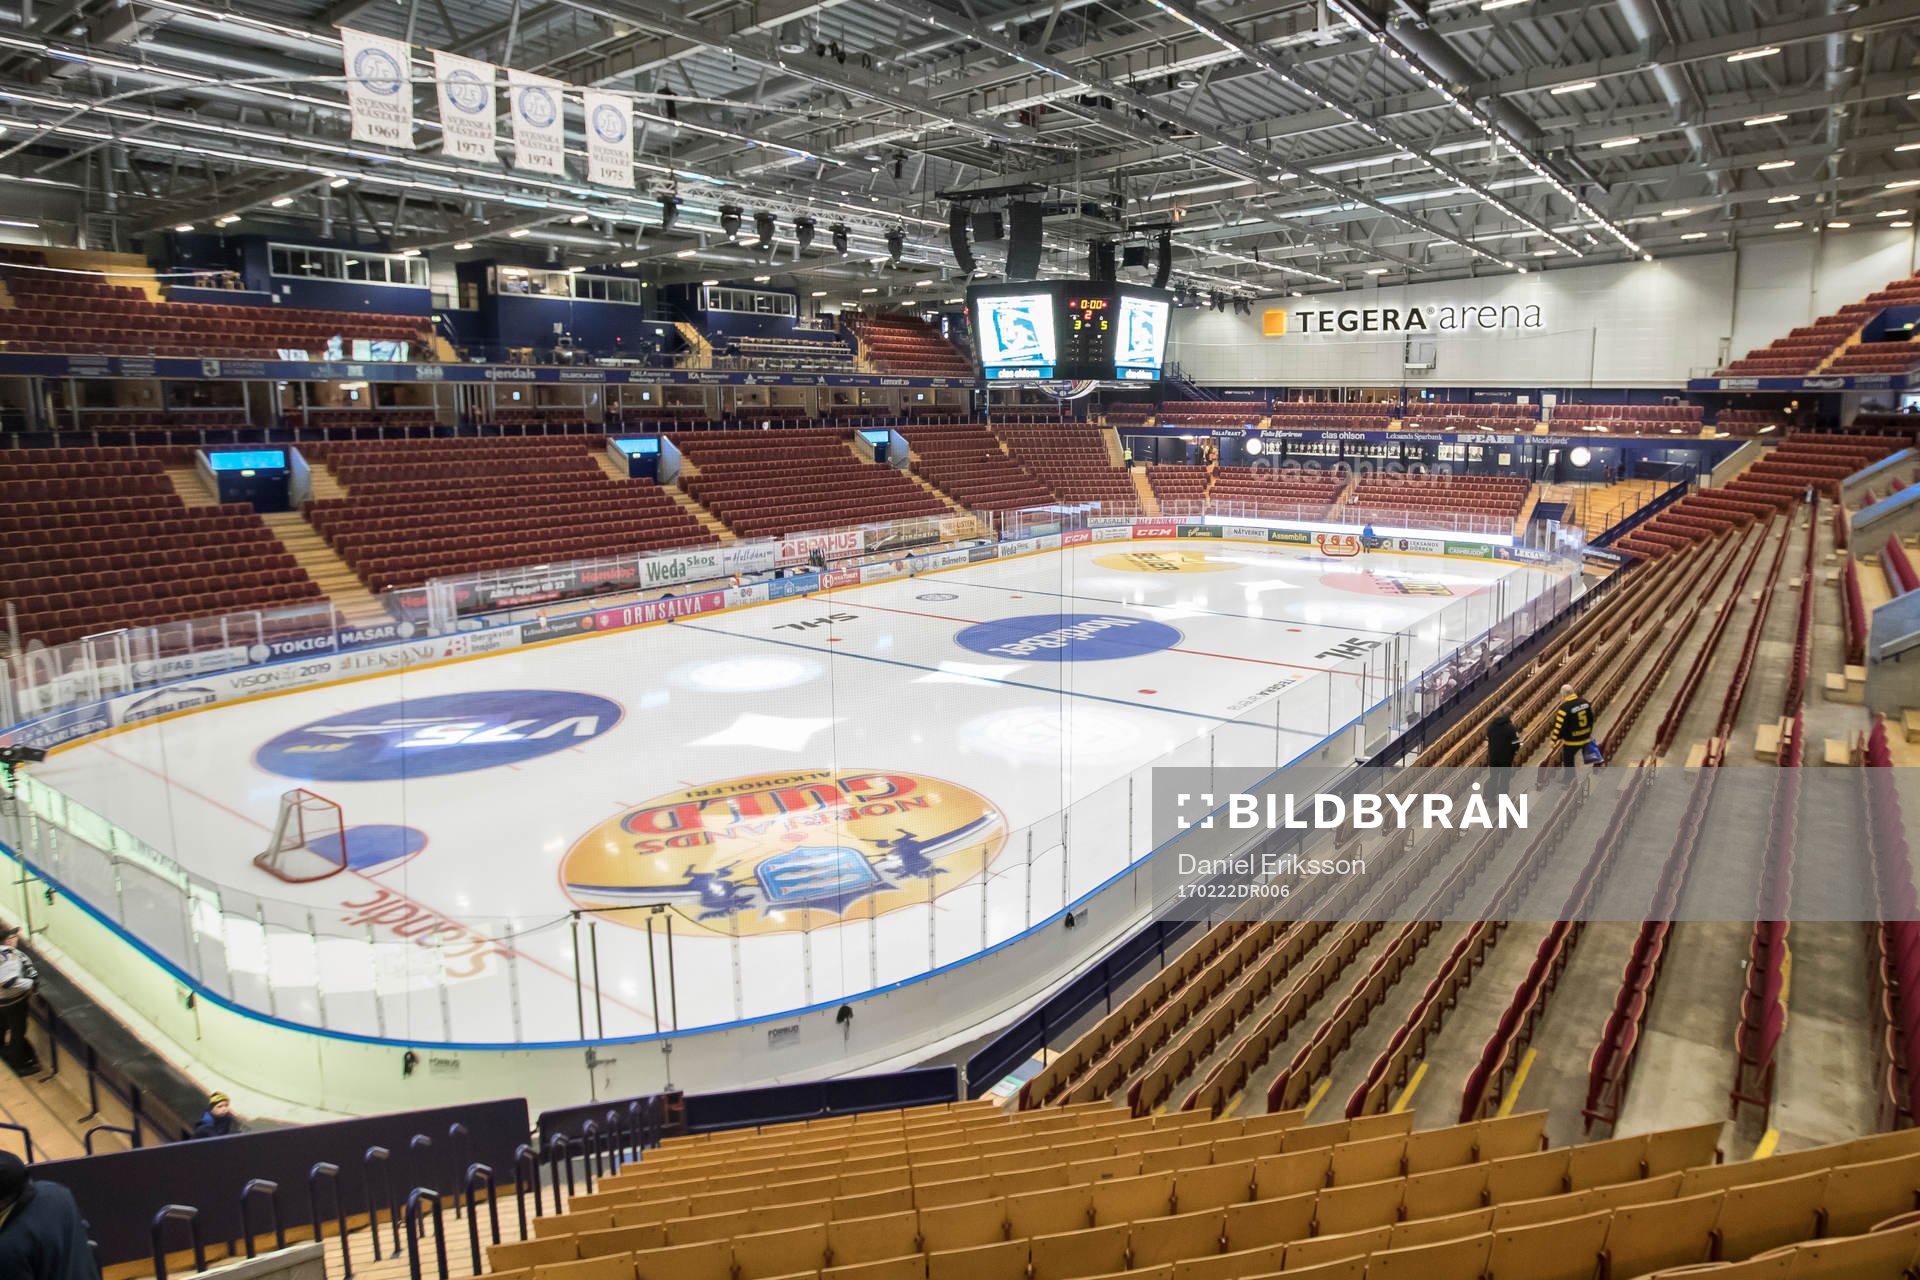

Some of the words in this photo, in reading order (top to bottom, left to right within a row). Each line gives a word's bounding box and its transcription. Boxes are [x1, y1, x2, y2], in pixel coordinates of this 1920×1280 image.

[367, 123, 400, 139] 1969
[456, 140, 486, 155] 1973
[528, 153, 553, 167] 1974
[600, 167, 624, 180] 1975
[1080, 300, 1102, 309] 0:00
[1084, 311, 1092, 320] 2
[1439, 303, 1544, 329] arena
[1074, 321, 1081, 330] 3
[484, 367, 536, 380] ejendals
[1321, 431, 1339, 439] clas
[1339, 431, 1366, 440] ohlson
[1385, 432, 1414, 440] Leksands
[1414, 433, 1443, 441] Sparbank
[1064, 534, 1089, 545] CCM
[1136, 528, 1172, 536] CCM
[1271, 531, 1308, 542] Assemblin
[646, 559, 687, 582] Weda
[687, 554, 715, 567] Skog
[623, 596, 702, 626] ORMSALVA
[771, 612, 859, 632] SHL
[271, 635, 336, 655] TOKIGA
[341, 625, 396, 644] MASAR
[988, 616, 1142, 660] NordicBet
[1314, 636, 1383, 661] SHL
[230, 672, 280, 689] VISION
[300, 662, 331, 678] 2019
[1577, 710, 1588, 727] 5
[395, 715, 599, 748] V75
[685, 771, 832, 799] ALKOHOLFRI
[619, 774, 918, 836] GULD
[340, 889, 515, 978] Scandic
